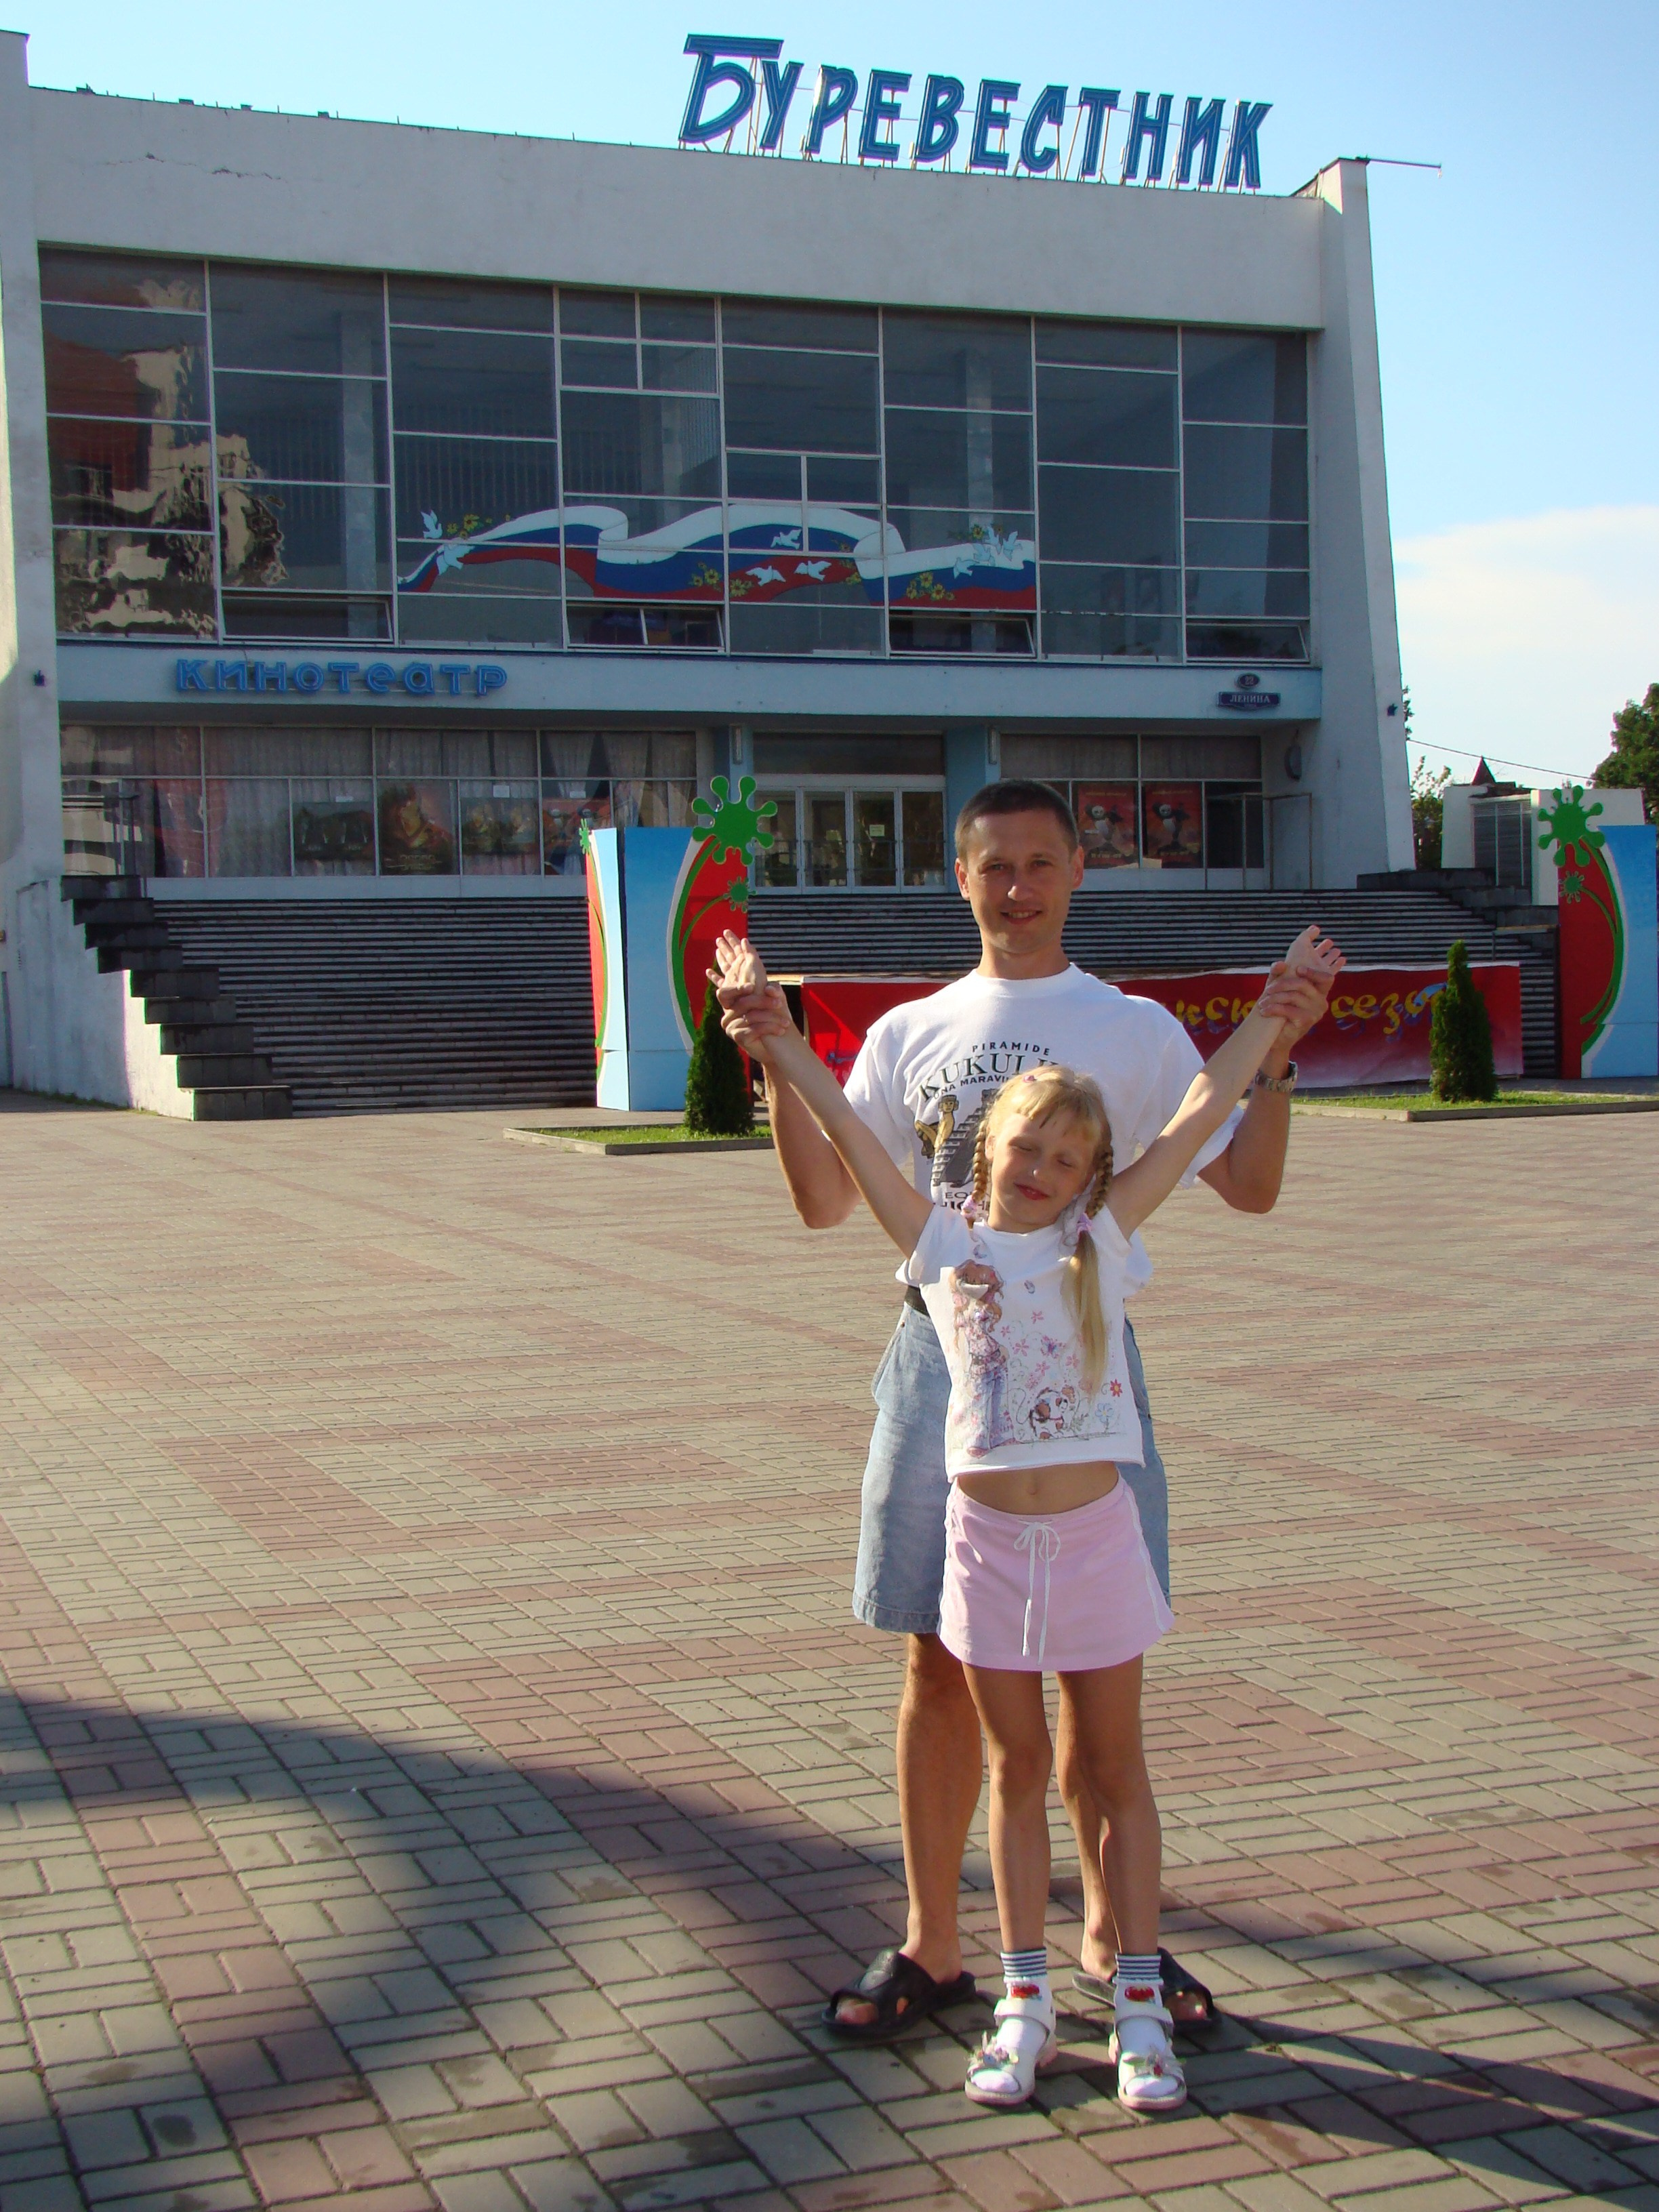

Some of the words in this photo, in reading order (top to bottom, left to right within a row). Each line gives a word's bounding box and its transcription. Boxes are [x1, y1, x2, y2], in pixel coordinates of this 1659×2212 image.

[678, 34, 1273, 190] БУРЕВЕСТНИК
[1230, 695, 1270, 703] ЛЕНИНА
[972, 1041, 1050, 1056] PIRAMIDE
[933, 1084, 956, 1100] UNA
